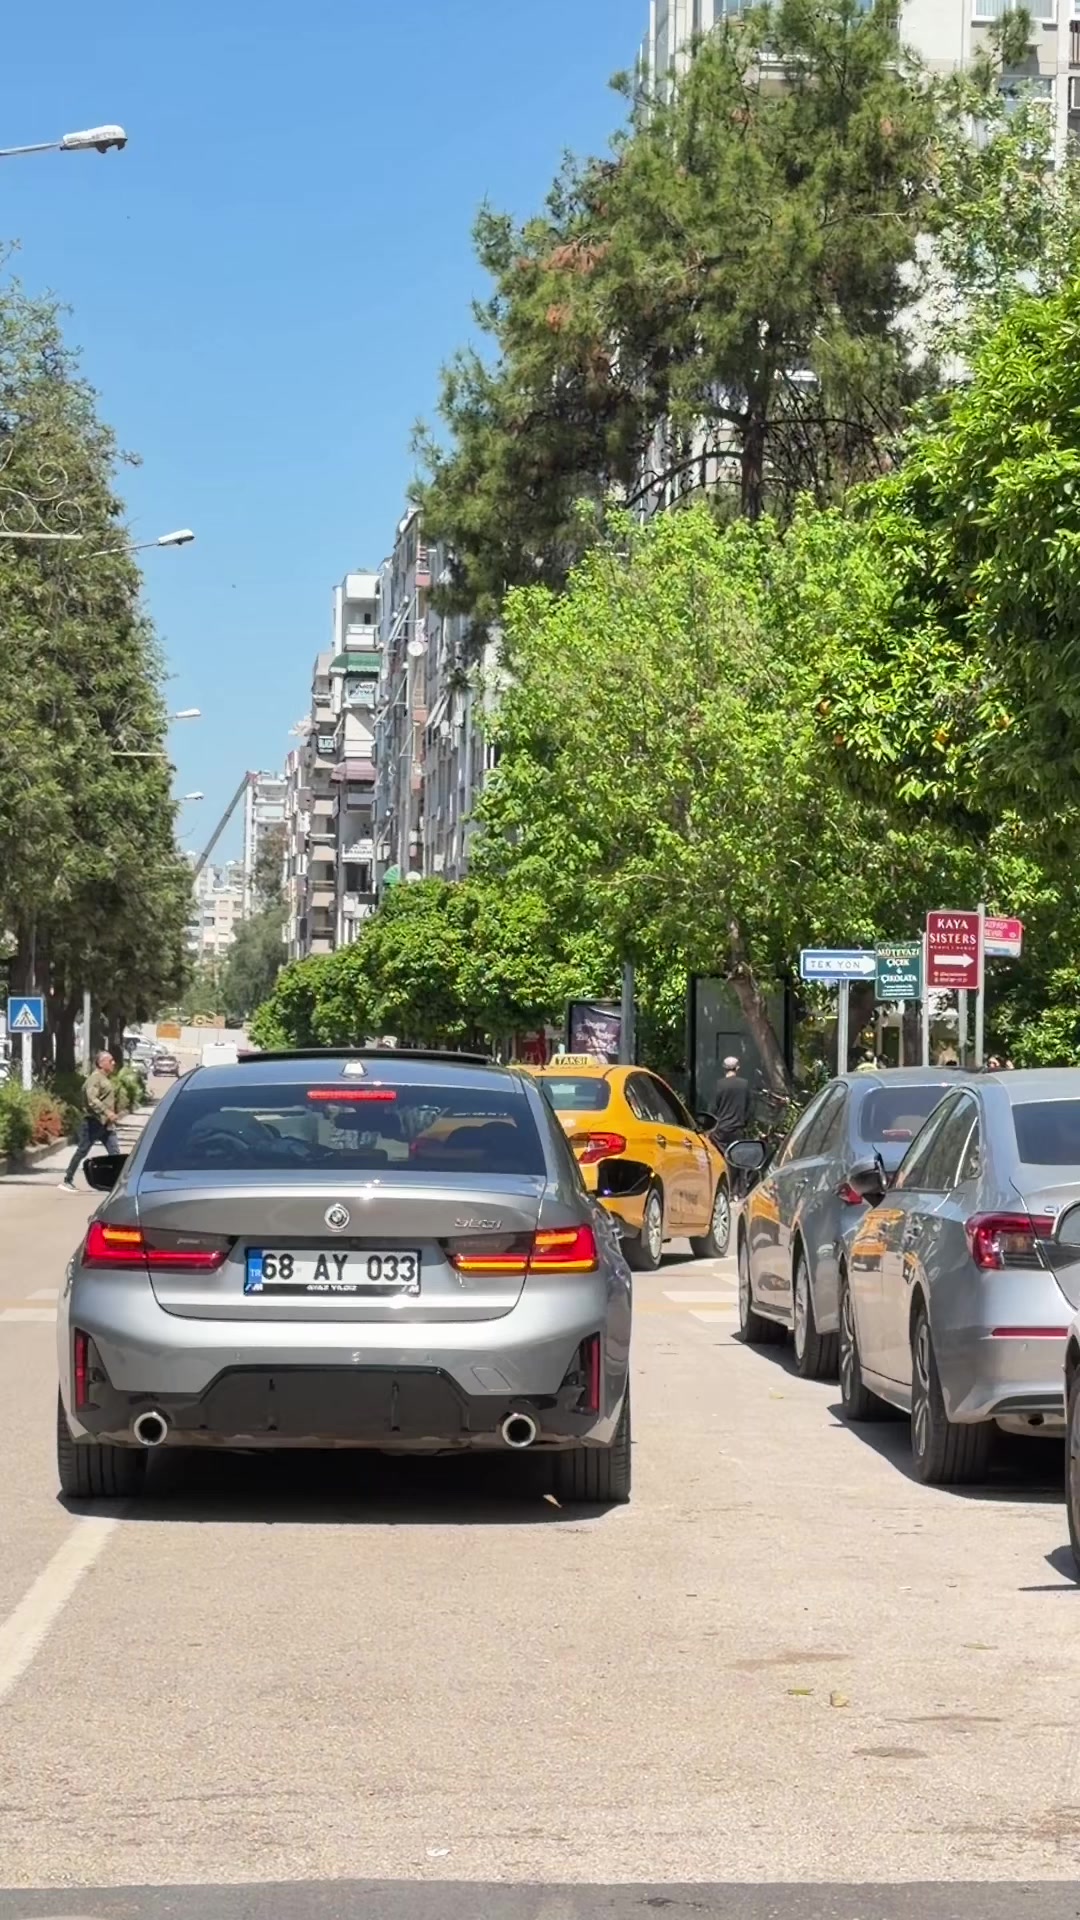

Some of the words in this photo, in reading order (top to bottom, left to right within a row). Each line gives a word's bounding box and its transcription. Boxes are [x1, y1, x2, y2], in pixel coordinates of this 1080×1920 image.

[937, 918, 969, 929] KAYA
[929, 933, 977, 945] SISTERS
[810, 960, 832, 969] TEK
[262, 1253, 294, 1280] 68
[313, 1253, 349, 1281] AY
[366, 1254, 416, 1282] 033
